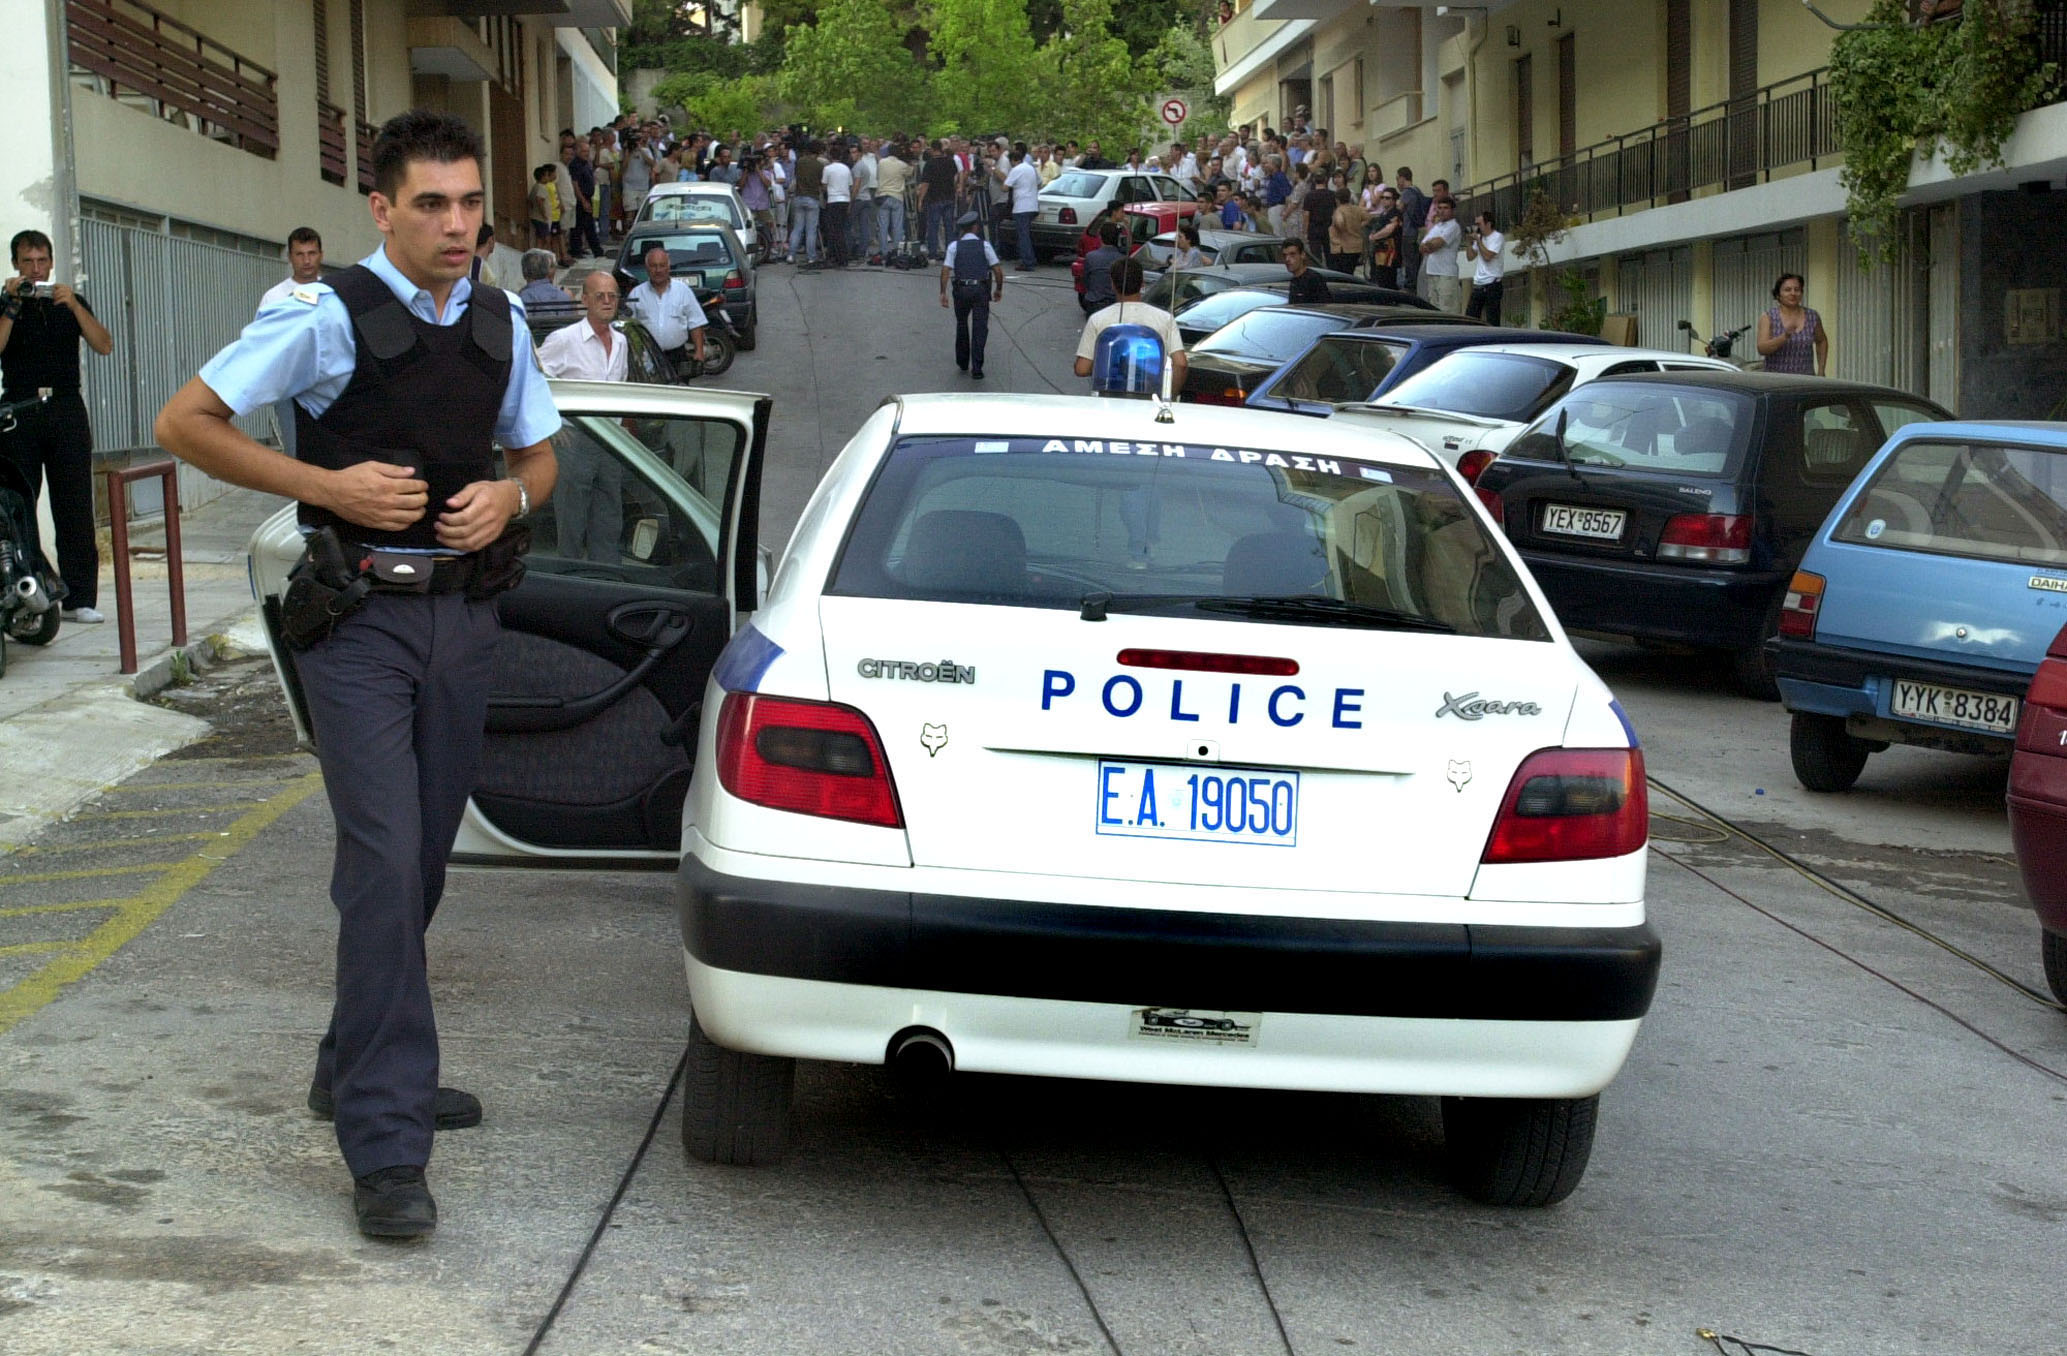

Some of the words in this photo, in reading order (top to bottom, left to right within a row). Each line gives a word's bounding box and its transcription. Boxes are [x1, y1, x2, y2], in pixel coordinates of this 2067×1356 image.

[1042, 439, 1185, 457] ΑΜΕΣΗ
[1211, 448, 1342, 475] ΔΡΑΣΗ
[857, 658, 976, 684] CITROËN
[1041, 669, 1365, 729] POLICE
[1435, 691, 1542, 721] Xsara
[1187, 774, 1294, 836] 19050
